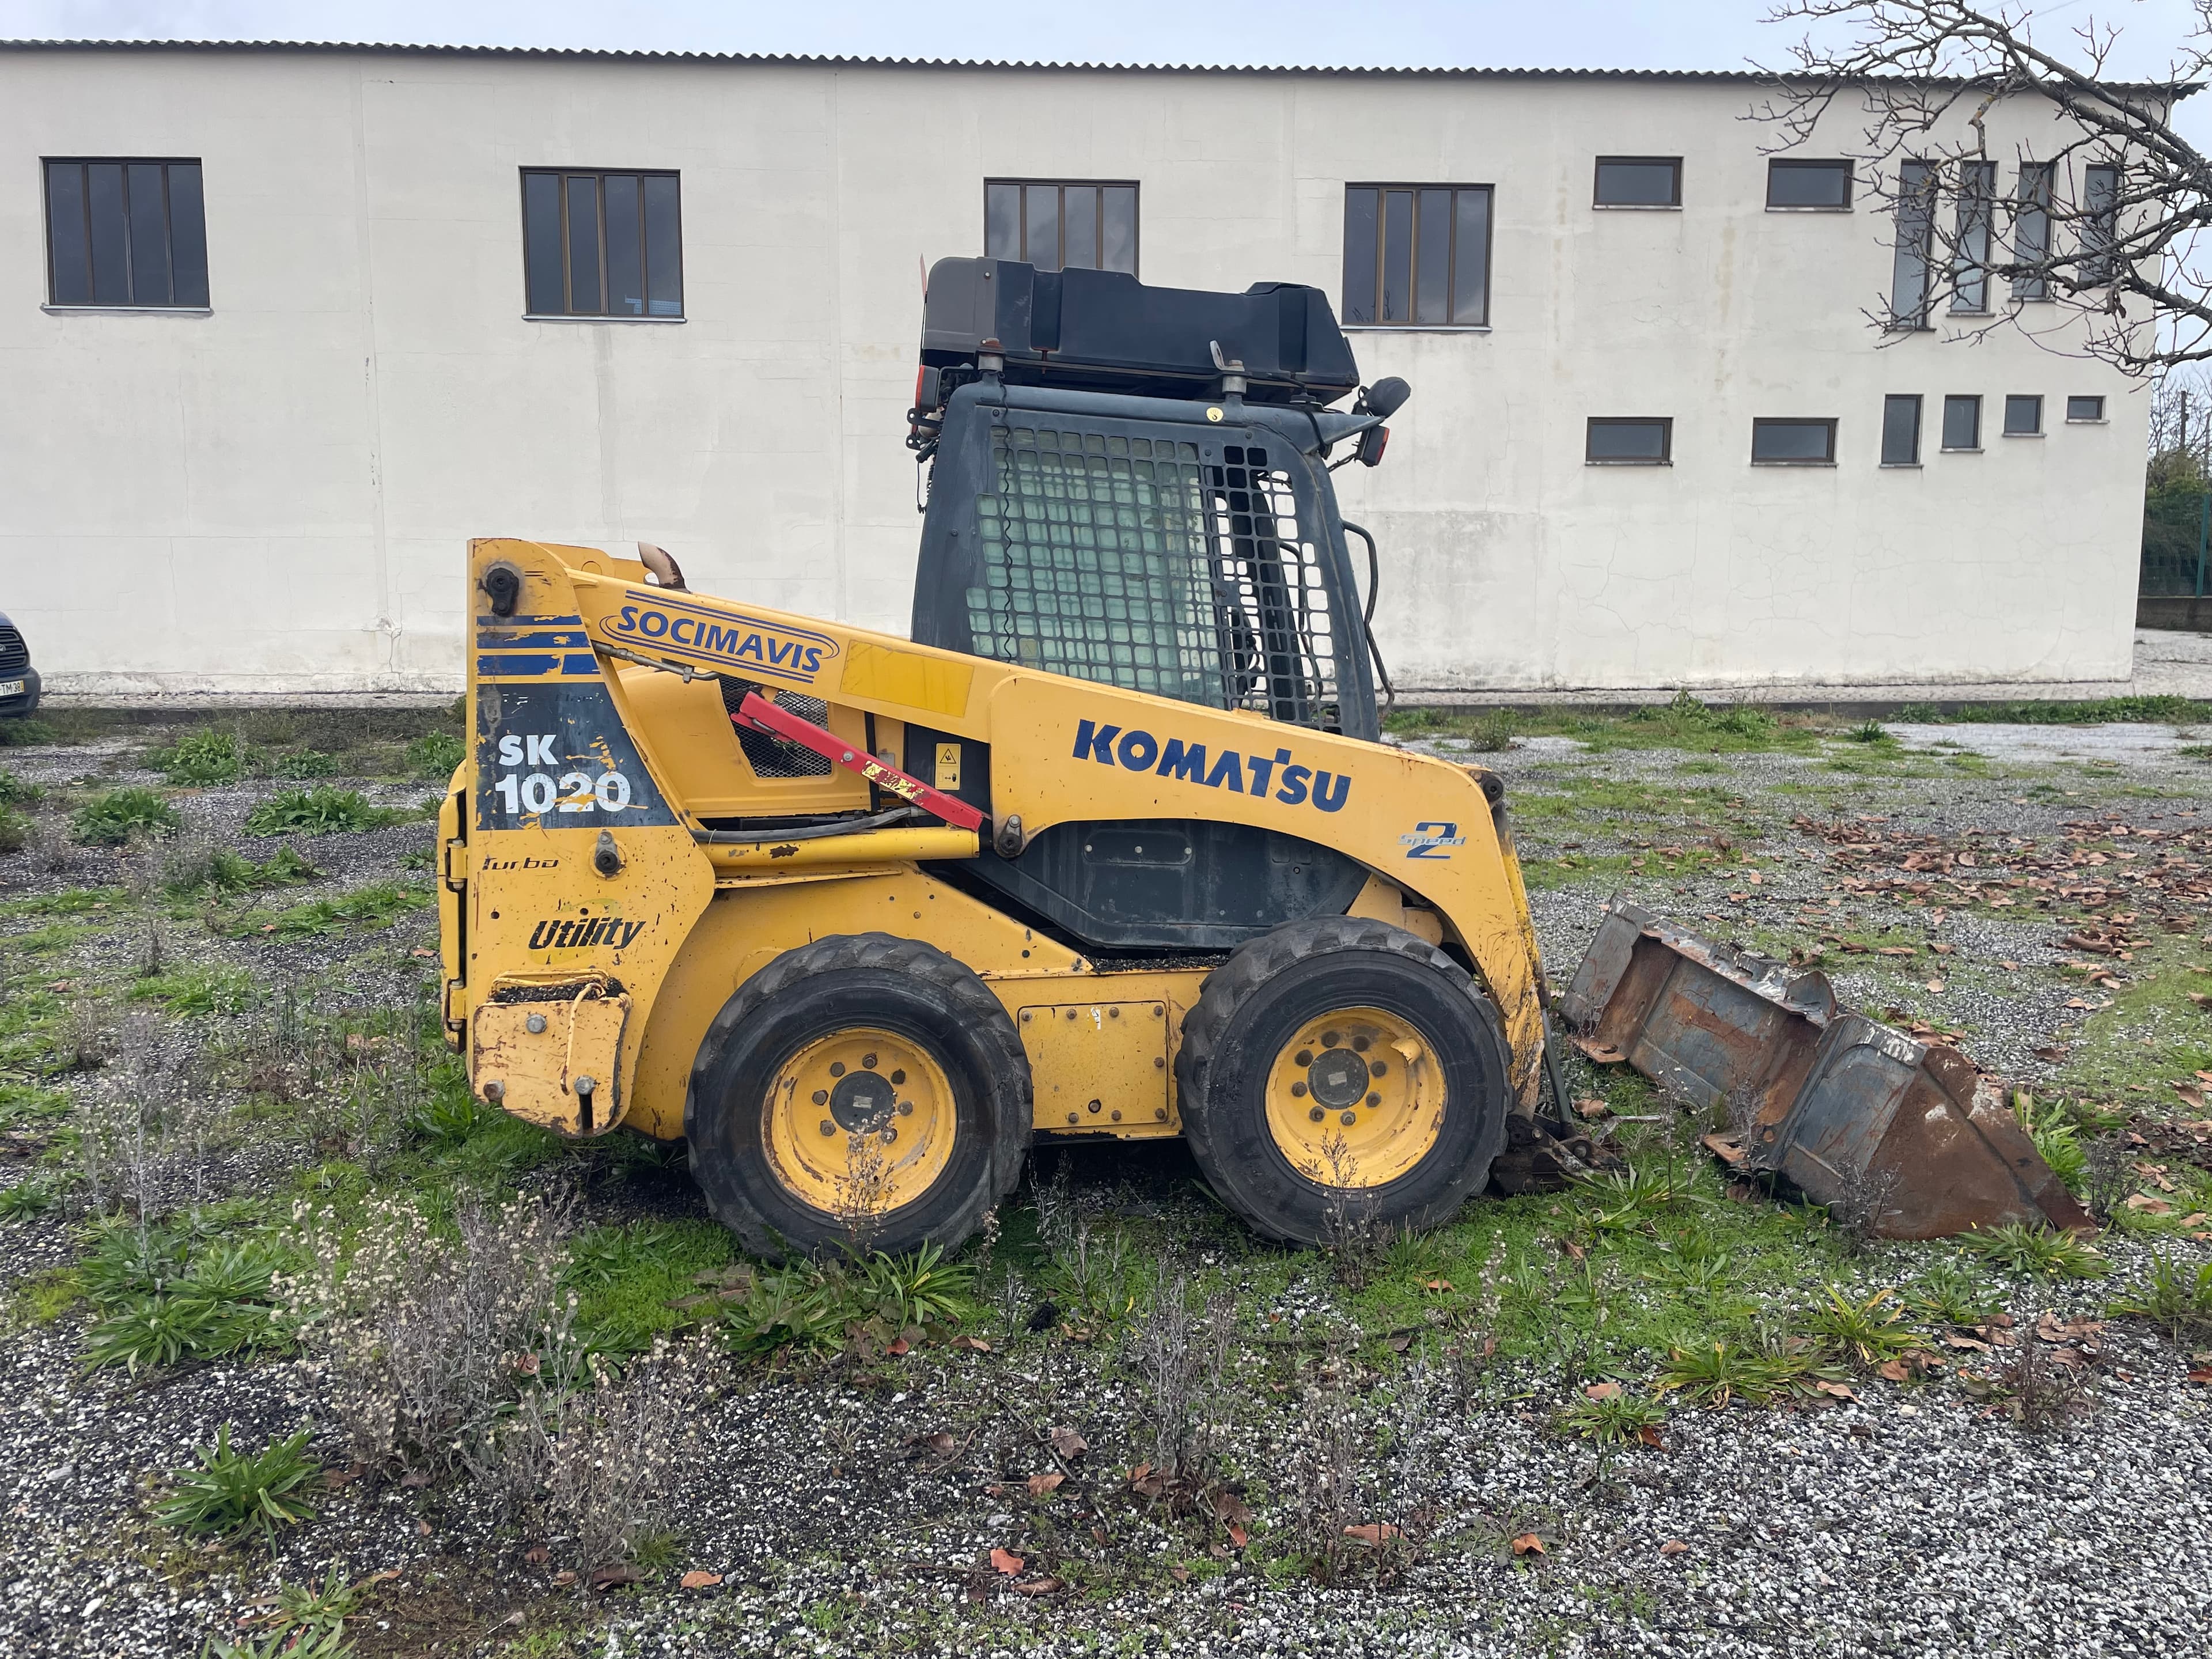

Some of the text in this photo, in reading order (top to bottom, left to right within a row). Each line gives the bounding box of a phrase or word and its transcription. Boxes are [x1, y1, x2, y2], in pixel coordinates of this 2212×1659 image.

[617, 605, 823, 673] SOCIMAVIS
[498, 734, 559, 766] SK
[1072, 719, 1351, 812] KOMATSU
[495, 772, 631, 813] 1020
[1397, 834, 1466, 847] Speed
[1406, 821, 1457, 859] 2
[529, 917, 646, 949] Utility
